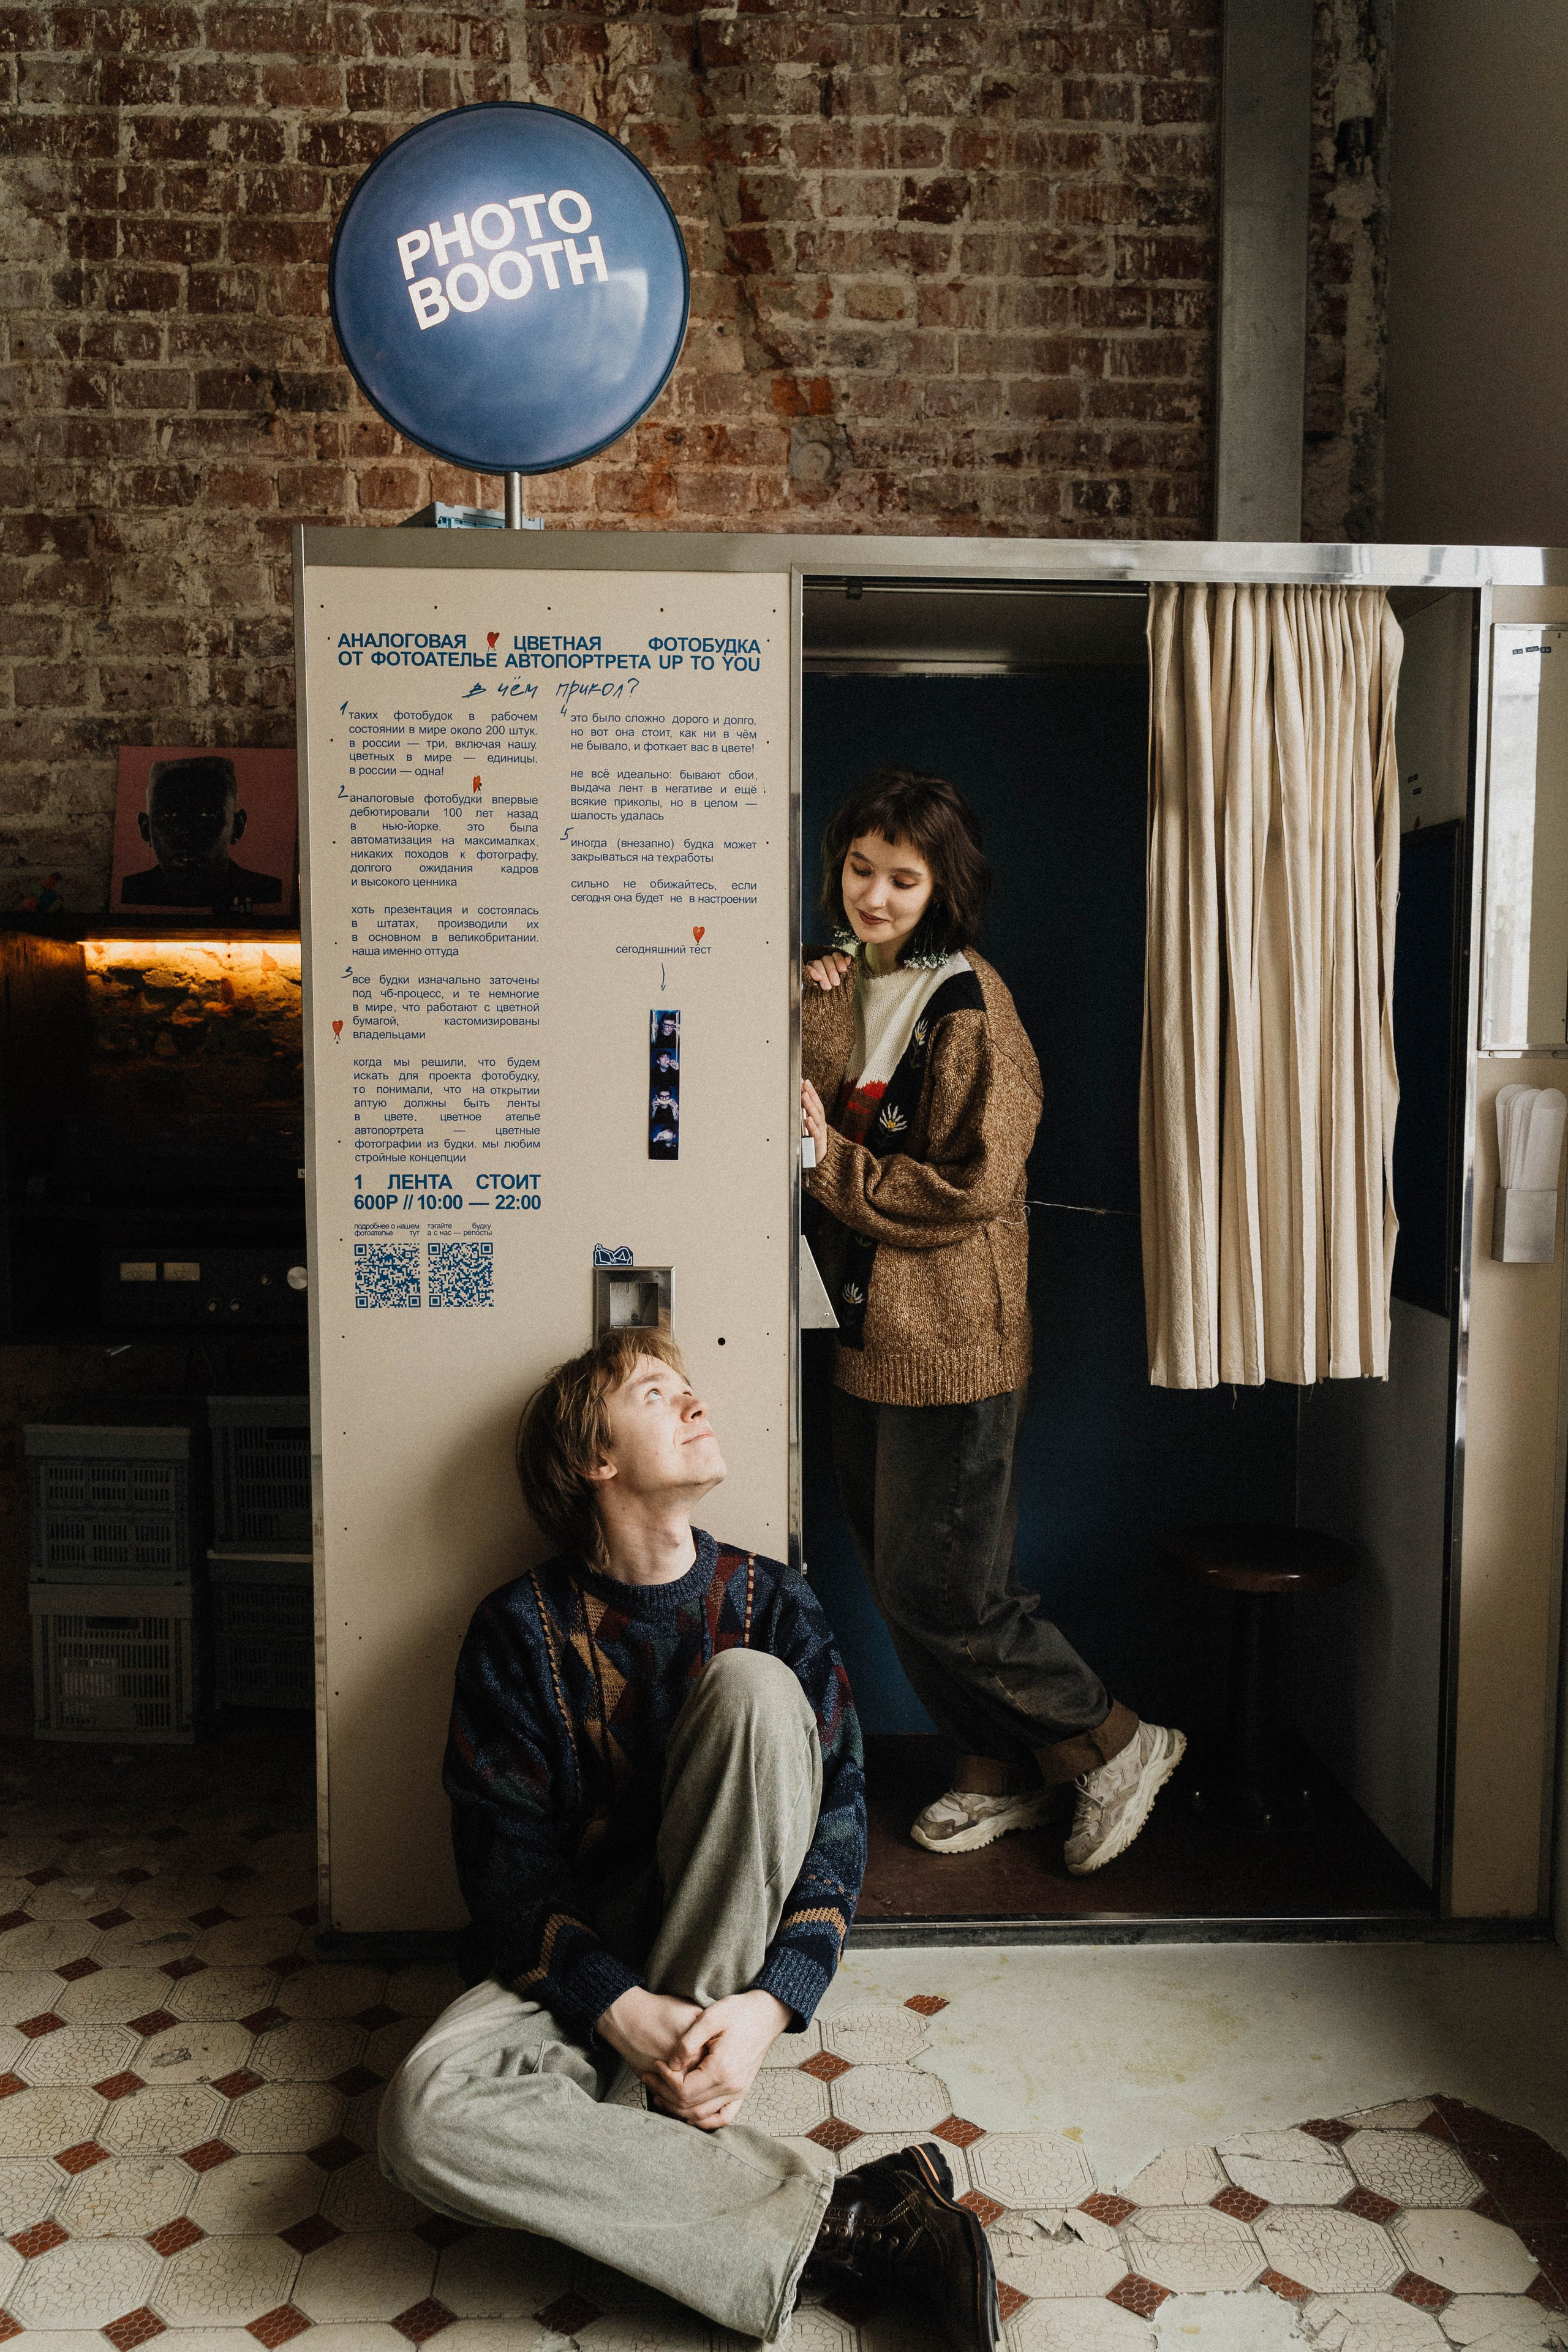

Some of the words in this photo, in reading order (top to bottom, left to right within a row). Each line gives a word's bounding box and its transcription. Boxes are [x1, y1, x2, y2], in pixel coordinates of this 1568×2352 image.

[397, 189, 592, 280] PHOTO
[408, 235, 609, 330] BOOTH
[337, 633, 466, 649] АНАЛОГОВАЯ
[514, 635, 601, 652] ЦВЕТНАЯ
[648, 636, 761, 656] ФОТОБУДКА
[337, 651, 363, 666] ОТ
[371, 651, 497, 668] ФОТОАТЕЛЬЕ
[505, 653, 651, 669] АВТОПОРТРЕТА
[659, 655, 683, 669] UP
[690, 655, 715, 671] TO
[722, 657, 760, 672] YOU
[340, 701, 349, 715] 1
[560, 704, 568, 717] 4
[393, 710, 453, 723] фотобудок
[491, 711, 538, 723] рабочем
[570, 714, 588, 723] это
[592, 712, 621, 723] было
[625, 715, 665, 723] сложно
[671, 715, 709, 726] дорого
[723, 717, 756, 726] долго,
[591, 769, 610, 778] всё
[617, 771, 672, 780] идеально:
[679, 769, 722, 780] бывают
[728, 769, 758, 780] сбои,
[337, 785, 349, 799] 2
[570, 784, 611, 794] выдача
[665, 785, 713, 794] негативе
[734, 785, 757, 796] ещё
[349, 794, 415, 803] аналоговые
[423, 793, 482, 806] фотобудки
[491, 796, 538, 807] впервые
[349, 806, 429, 819] дебютировали
[443, 807, 462, 818] 100
[507, 810, 539, 820] назад
[620, 812, 665, 823] удалась
[382, 820, 442, 833] нью-йорке.
[467, 823, 485, 832] это
[510, 822, 538, 832] была
[559, 827, 575, 840] 5
[350, 837, 432, 846] автоматизация
[464, 837, 538, 846] максималках.
[571, 840, 607, 849] иногда
[617, 838, 674, 850] (внезапно)
[684, 839, 714, 851] будка
[404, 851, 449, 860] походов
[477, 850, 538, 862] фотографу,
[571, 853, 638, 864] закрываться
[657, 852, 714, 864] техработы
[350, 864, 392, 874] долгого
[419, 865, 473, 874] ожидания
[500, 865, 539, 876] кадров
[413, 878, 458, 888] ценника
[571, 880, 609, 889] сильно
[649, 878, 717, 891] обижайтесь,
[571, 894, 611, 903] сегодня
[635, 892, 664, 904] будет
[698, 895, 757, 906] настроении
[384, 906, 453, 916] презентация
[424, 948, 459, 958] оттуда
[616, 944, 686, 955] сегодняшний
[341, 966, 353, 979] 3
[379, 974, 410, 987] будки
[352, 990, 372, 1000] под
[380, 988, 444, 1000] чб-процесс,
[352, 1015, 399, 1028] бумагой,
[444, 1018, 540, 1028] кастомизированы
[353, 1031, 426, 1041] владельцами
[353, 1059, 382, 1068] когда
[421, 1059, 466, 1069] решили,
[507, 1057, 540, 1069] будем
[398, 1072, 418, 1082] для
[429, 1072, 472, 1082] проекта
[481, 1070, 540, 1083] фотобудку,
[376, 1086, 432, 1095] понимали,
[490, 1087, 540, 1097] открытии
[353, 1099, 387, 1110] аптую
[403, 1100, 447, 1109] должны
[463, 1098, 490, 1108] быть
[354, 1139, 421, 1150] фотографии
[443, 1139, 477, 1151] будки.
[503, 1139, 541, 1148] любим
[355, 1152, 407, 1164] стройные
[409, 1155, 466, 1164] концепции
[355, 1174, 361, 1189] 1
[388, 1174, 453, 1189] ЛЕНТА
[476, 1174, 541, 1189] СТОИТ
[418, 1194, 462, 1210] 10:00
[495, 1194, 541, 1210] 22:00
[354, 1222, 390, 1231] подробнее
[472, 1222, 492, 1231] будку
